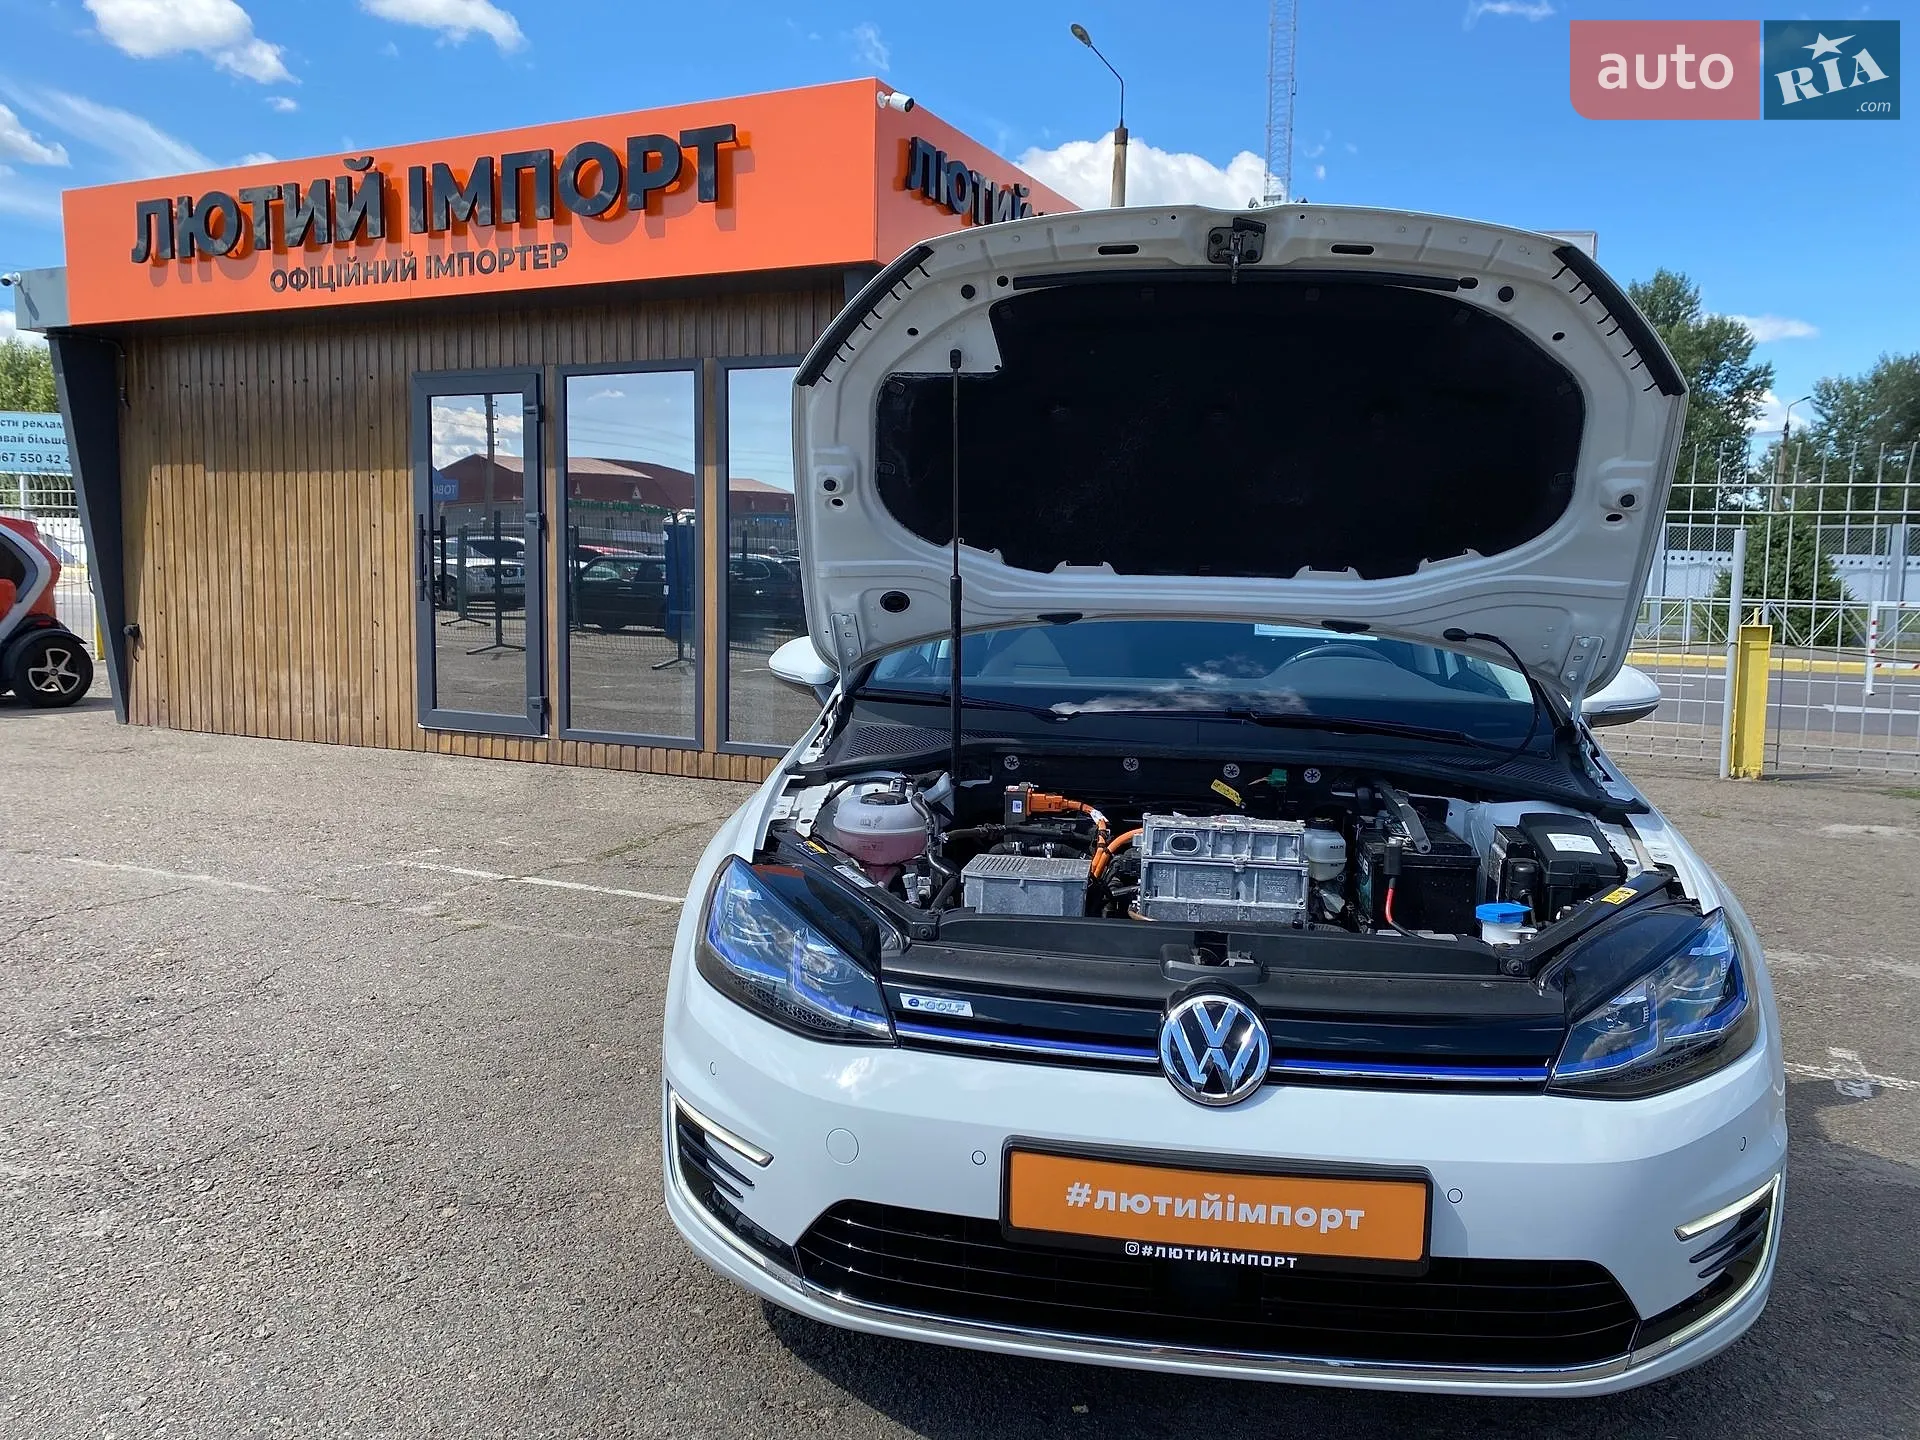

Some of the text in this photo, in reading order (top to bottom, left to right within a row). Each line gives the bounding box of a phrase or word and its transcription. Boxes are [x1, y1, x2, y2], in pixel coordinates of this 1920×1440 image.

[131, 123, 737, 264] ЛЮТИЙ ІМПОРТ
[269, 242, 569, 293] ОФІЦІЙНИЙ ІМПОРТЕР
[0, 452, 16, 463] 67
[20, 452, 42, 463] 550
[46, 454, 61, 464] 42
[1065, 1181, 1365, 1234] #лютийімпорт
